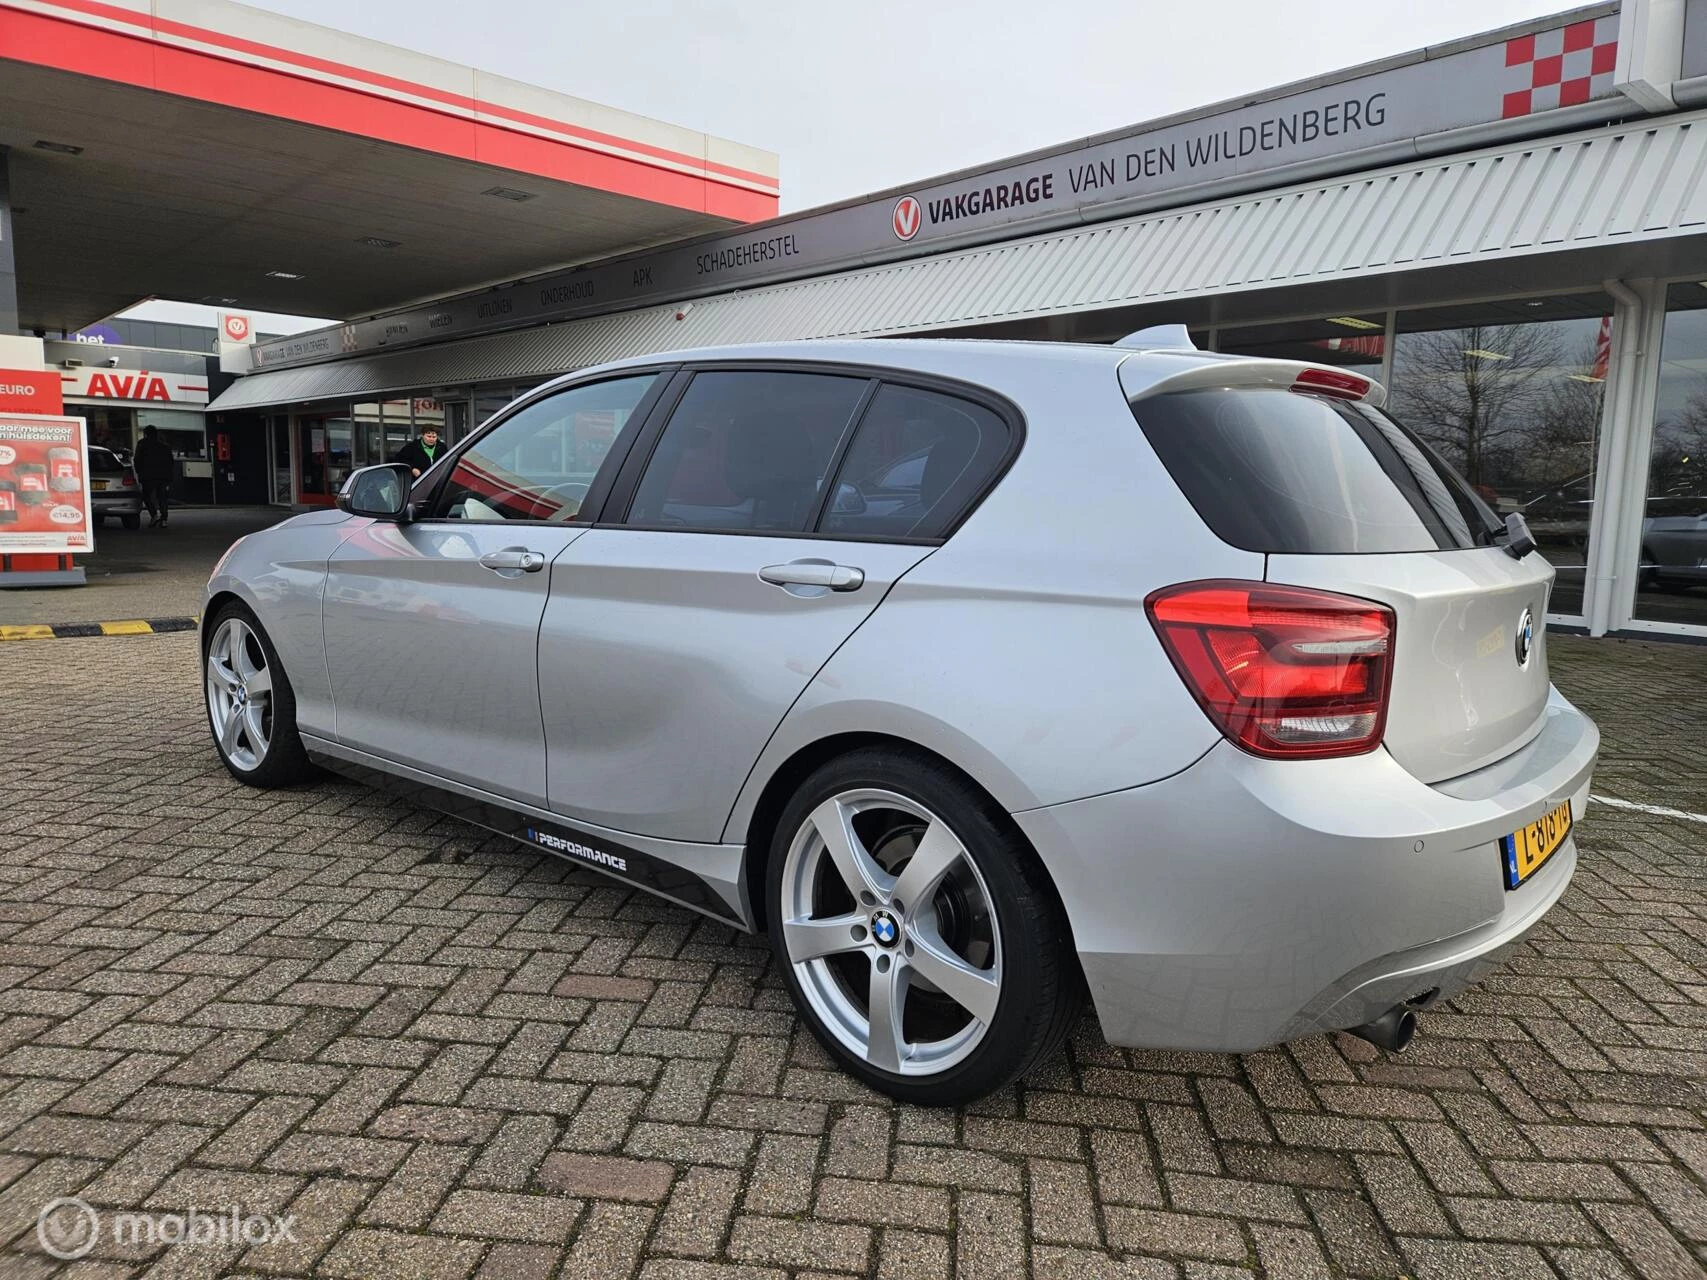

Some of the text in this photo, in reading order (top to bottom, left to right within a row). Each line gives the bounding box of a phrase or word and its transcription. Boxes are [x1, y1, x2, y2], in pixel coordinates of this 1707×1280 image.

[929, 173, 1054, 224] VAKGARAGE
[1067, 157, 1115, 194] VAN
[1126, 143, 1176, 182] DEN
[1185, 92, 1386, 168] WILDENBERG
[696, 234, 800, 275] SCHADEHERSTEL
[633, 265, 654, 288] APK
[540, 280, 594, 306] ONDERHOUD
[0, 383, 35, 396] EURO
[539, 832, 627, 871] PERFORMANCE
